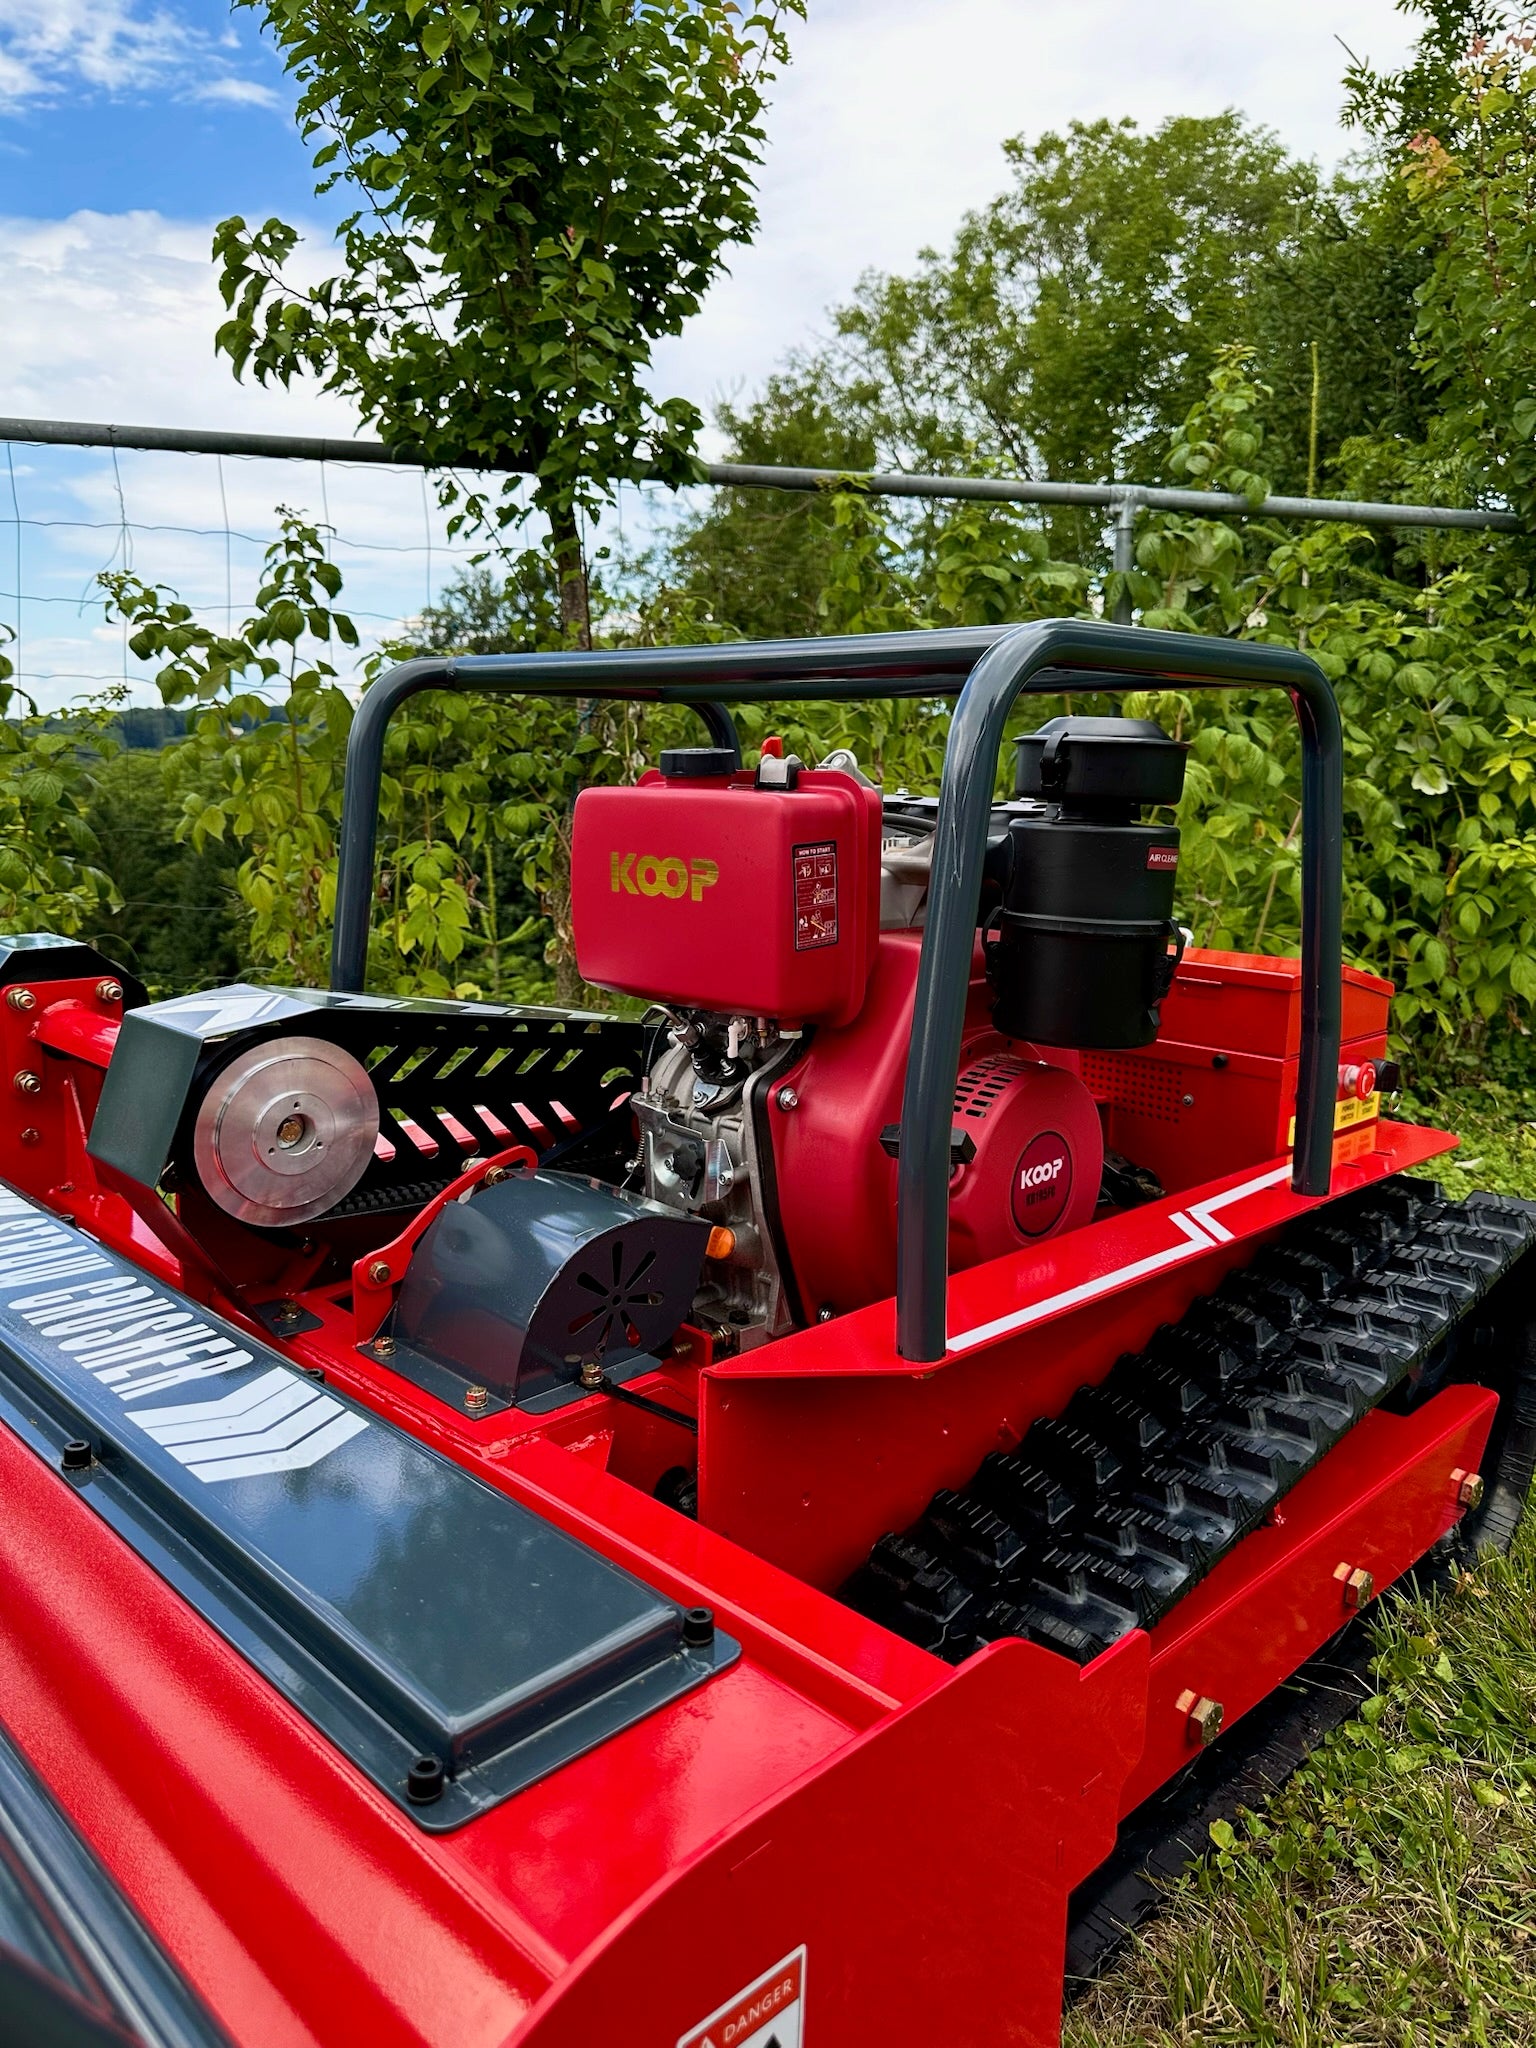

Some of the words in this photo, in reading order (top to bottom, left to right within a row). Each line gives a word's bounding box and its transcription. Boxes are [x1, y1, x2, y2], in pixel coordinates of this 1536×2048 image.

[610, 851, 719, 902] KOOP
[1149, 853, 1161, 862] AIR
[1161, 855, 1178, 863] CLEANE
[1021, 1158, 1063, 1190] KOOP
[7, 1276, 254, 1401] CRUSHER
[724, 1978, 792, 2041] DANGER
